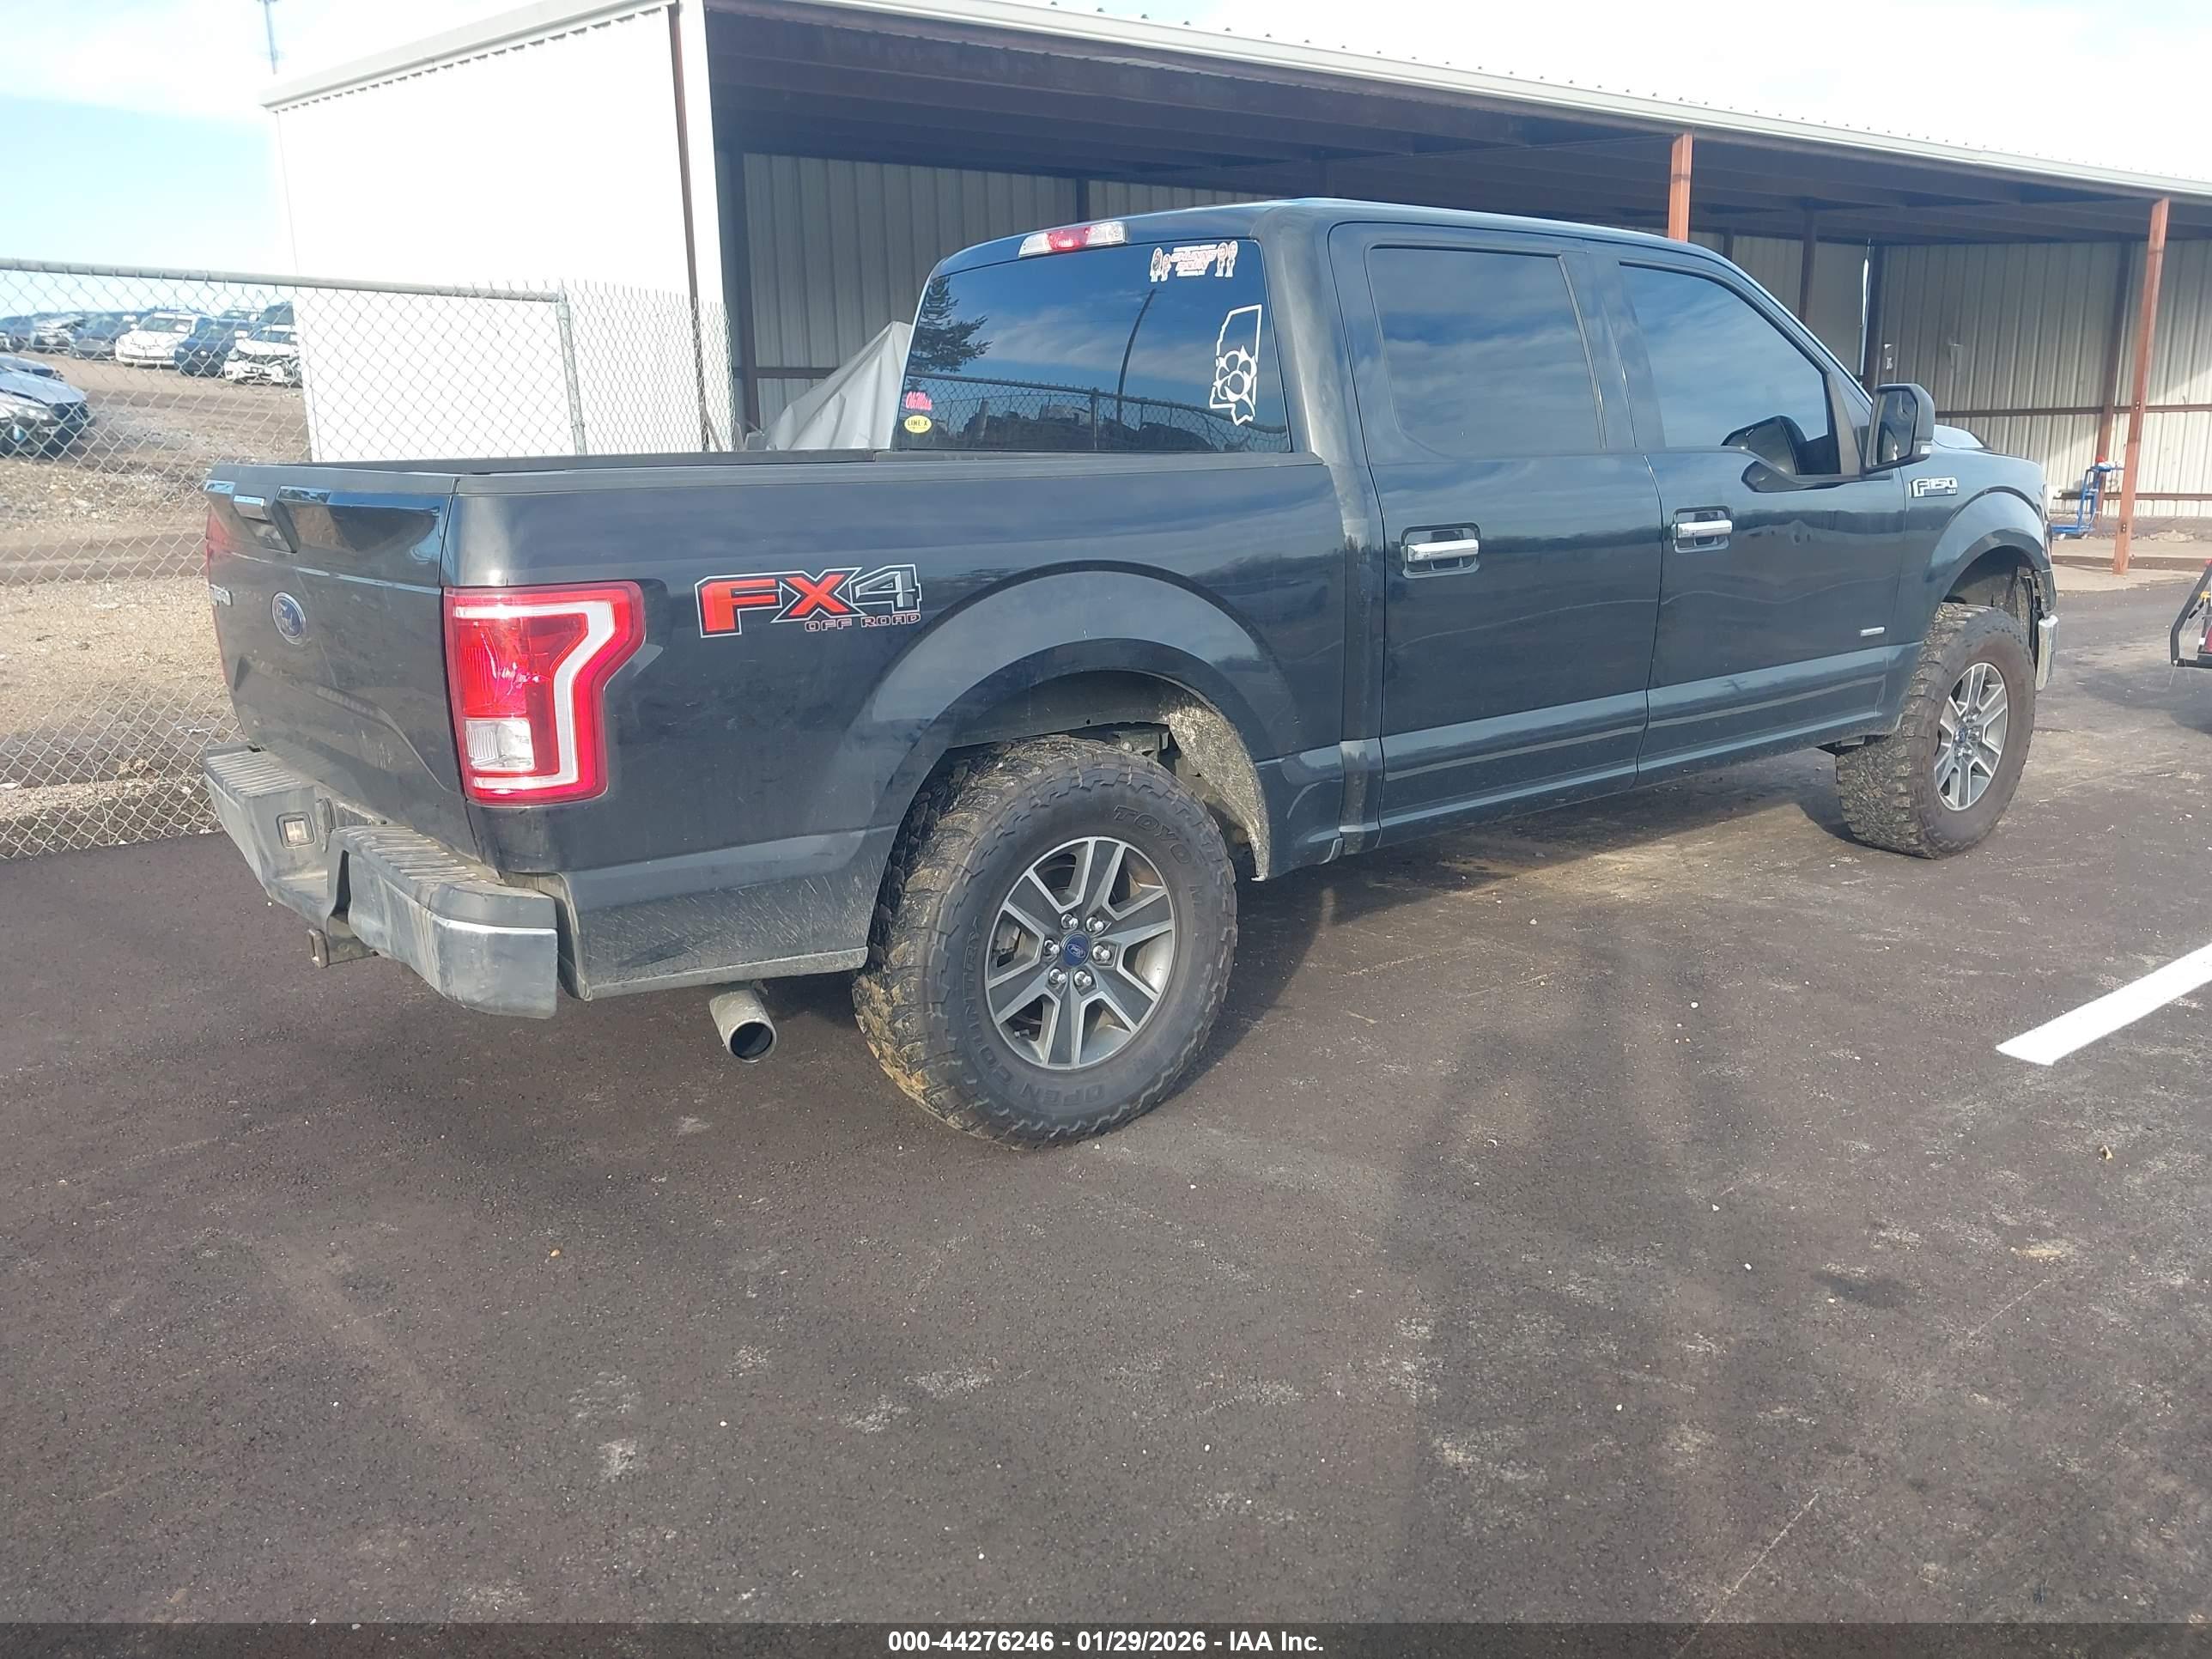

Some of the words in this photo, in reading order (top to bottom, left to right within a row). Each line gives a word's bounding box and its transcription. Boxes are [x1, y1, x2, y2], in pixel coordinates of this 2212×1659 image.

[695, 563, 922, 638] FX4
[804, 617, 853, 632] OFF
[860, 612, 921, 628] ROAD
[1114, 804, 1192, 865] TOYO
[963, 915, 1011, 1085] COUNTRY
[1020, 1083, 1105, 1107] OPEN
